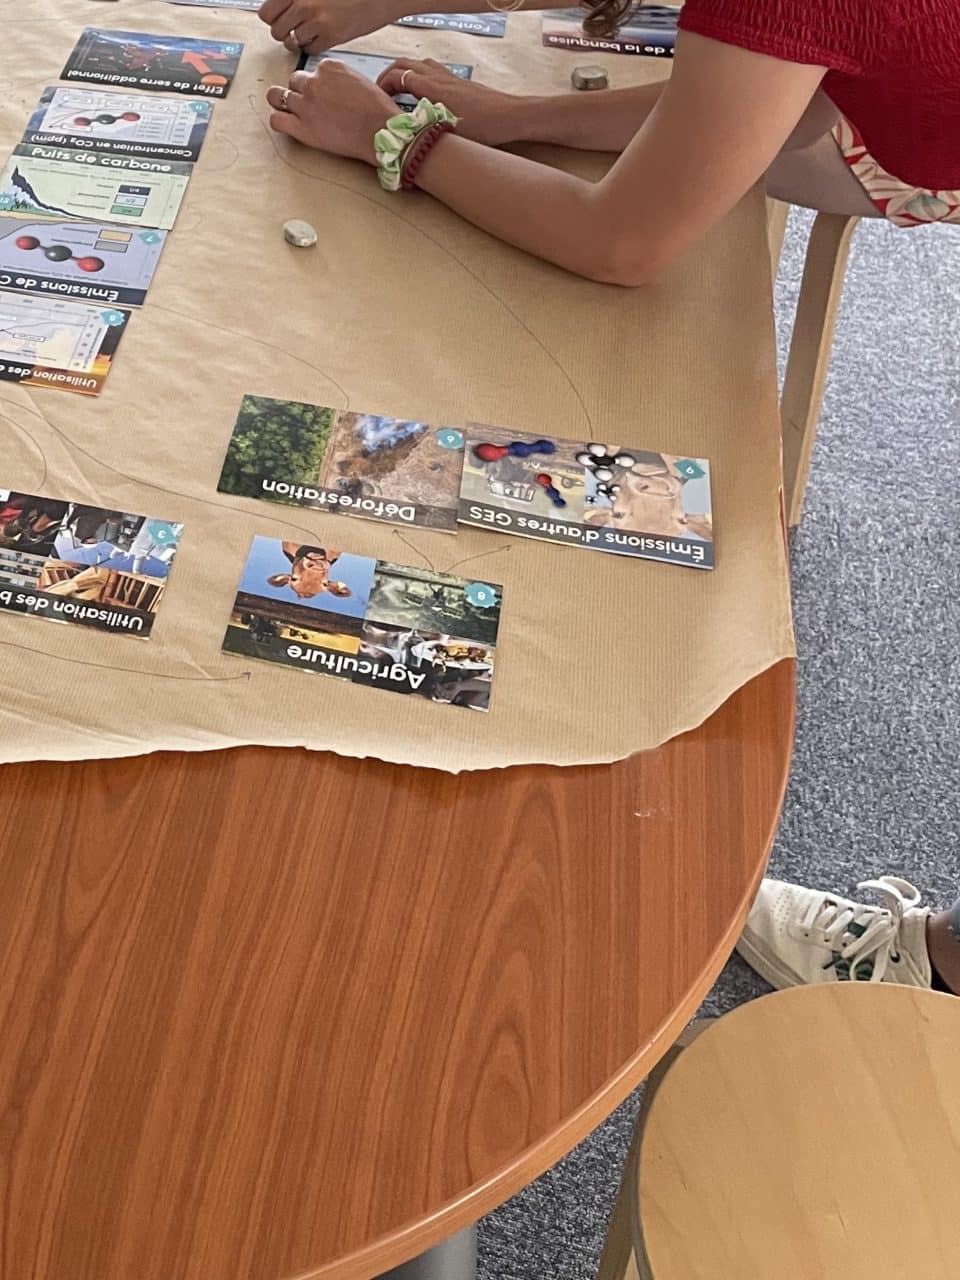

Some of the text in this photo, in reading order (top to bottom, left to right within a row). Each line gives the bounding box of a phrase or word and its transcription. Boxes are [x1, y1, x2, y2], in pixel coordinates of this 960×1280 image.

[416, 18, 446, 28] des
[448, 22, 490, 33] Fonte
[548, 36, 620, 52] banquise
[624, 44, 640, 54] la
[644, 44, 666, 55] de
[67, 69, 223, 94] Effet de serre additionnel
[31, 134, 67, 145] (ppm)
[96, 142, 110, 150] en
[113, 142, 192, 158] Concentration
[32, 146, 172, 172] Puits de carbone
[15, 276, 37, 289] de
[40, 280, 119, 302] Émissions
[8, 366, 31, 378] des
[32, 369, 98, 388] Utilisation
[262, 479, 416, 521] Déforestation
[158, 530, 166, 540] 3
[468, 505, 705, 562] Émissions d'autres GES
[16, 592, 48, 612] des
[478, 592, 486, 600] 8
[52, 600, 144, 630] Utilisation
[286, 644, 426, 690] Agriculture
